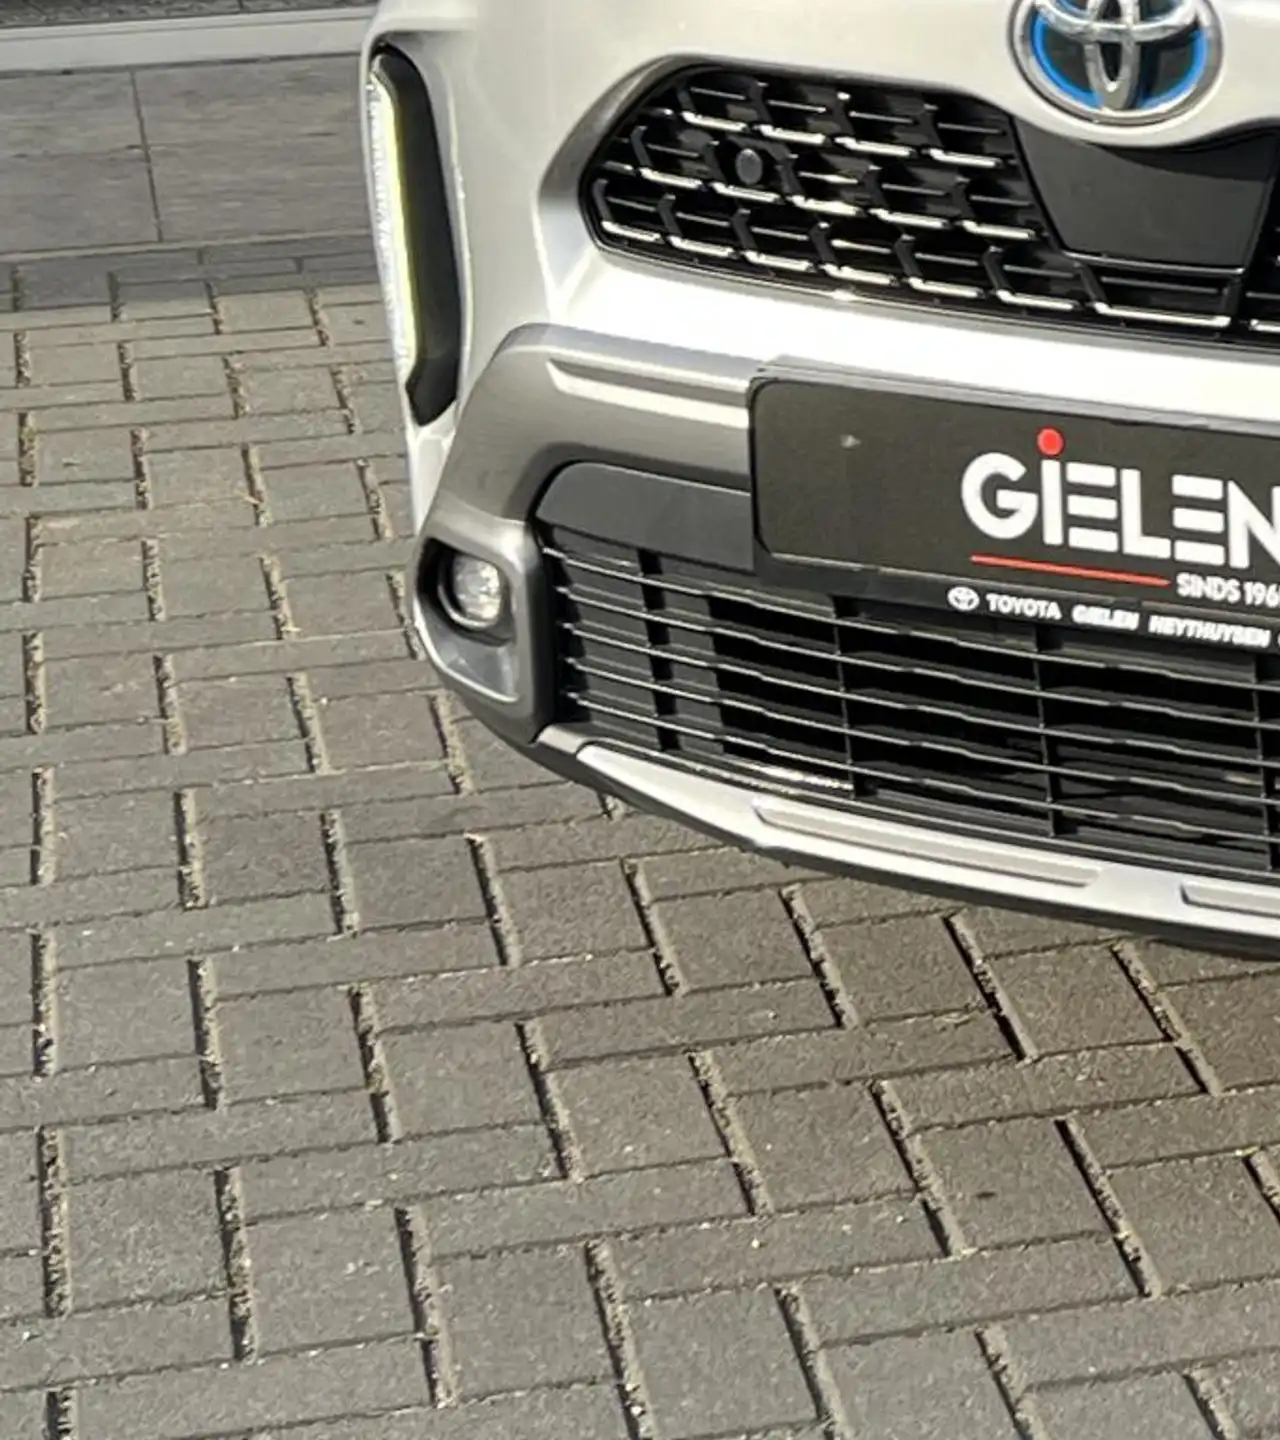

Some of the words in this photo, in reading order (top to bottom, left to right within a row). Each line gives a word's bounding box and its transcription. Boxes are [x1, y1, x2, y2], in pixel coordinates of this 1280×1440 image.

[1176, 572, 1241, 603] SINDS
[987, 594, 1062, 620] TOYOTA
[1071, 605, 1139, 630] GIELEN
